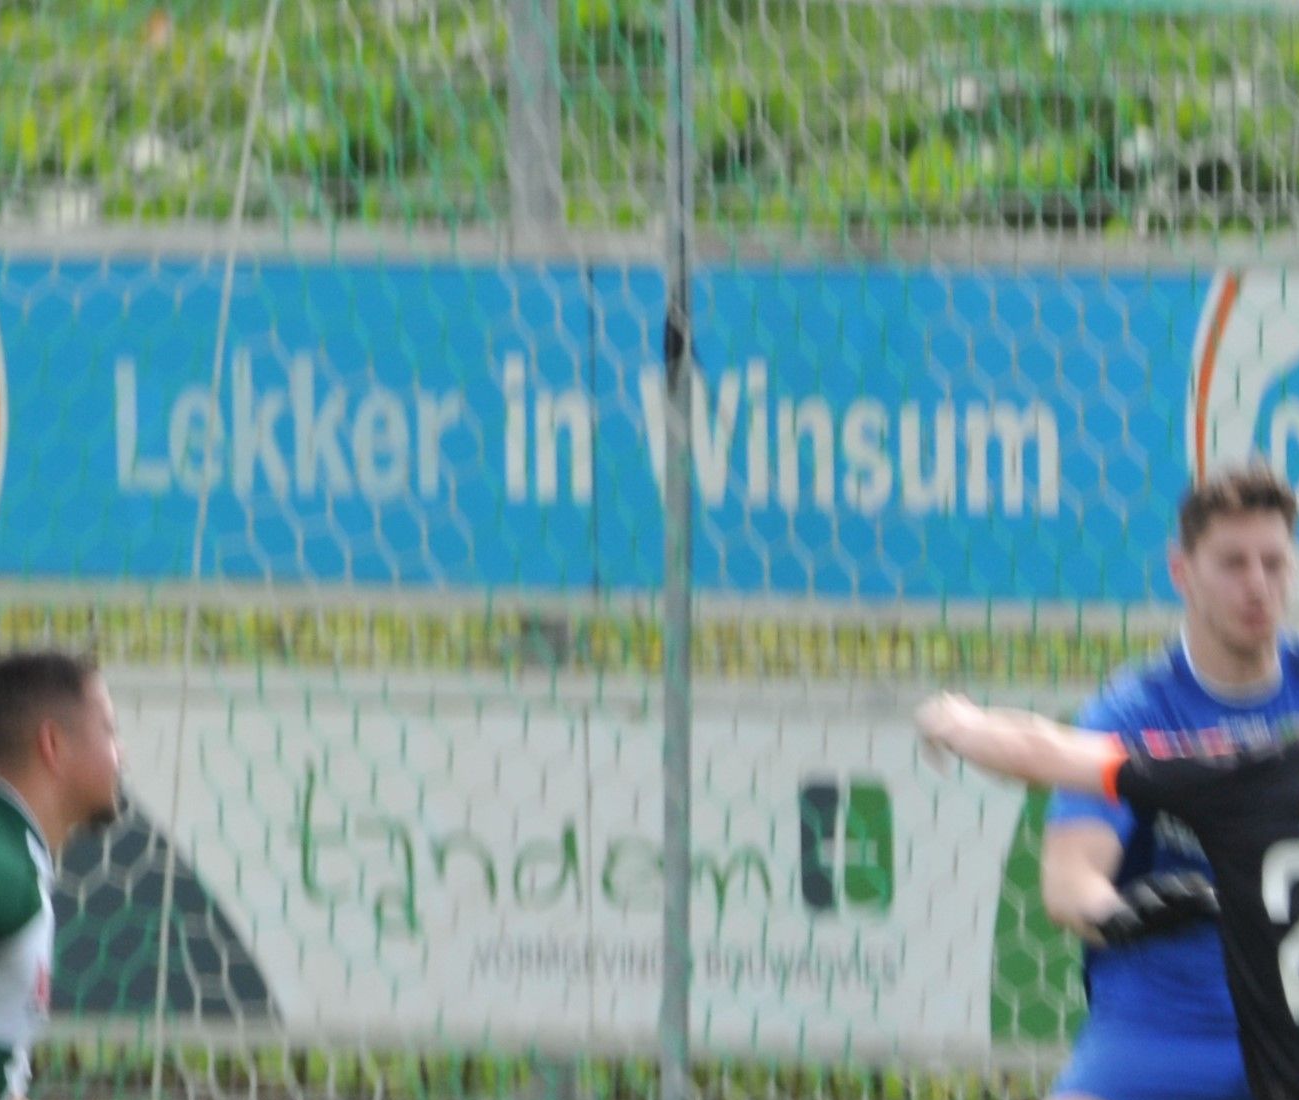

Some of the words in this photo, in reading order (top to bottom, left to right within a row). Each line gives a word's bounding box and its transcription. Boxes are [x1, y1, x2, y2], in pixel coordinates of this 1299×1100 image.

[113, 350, 468, 502] Lekker
[503, 352, 593, 505] in
[639, 356, 1061, 519] Winsum
